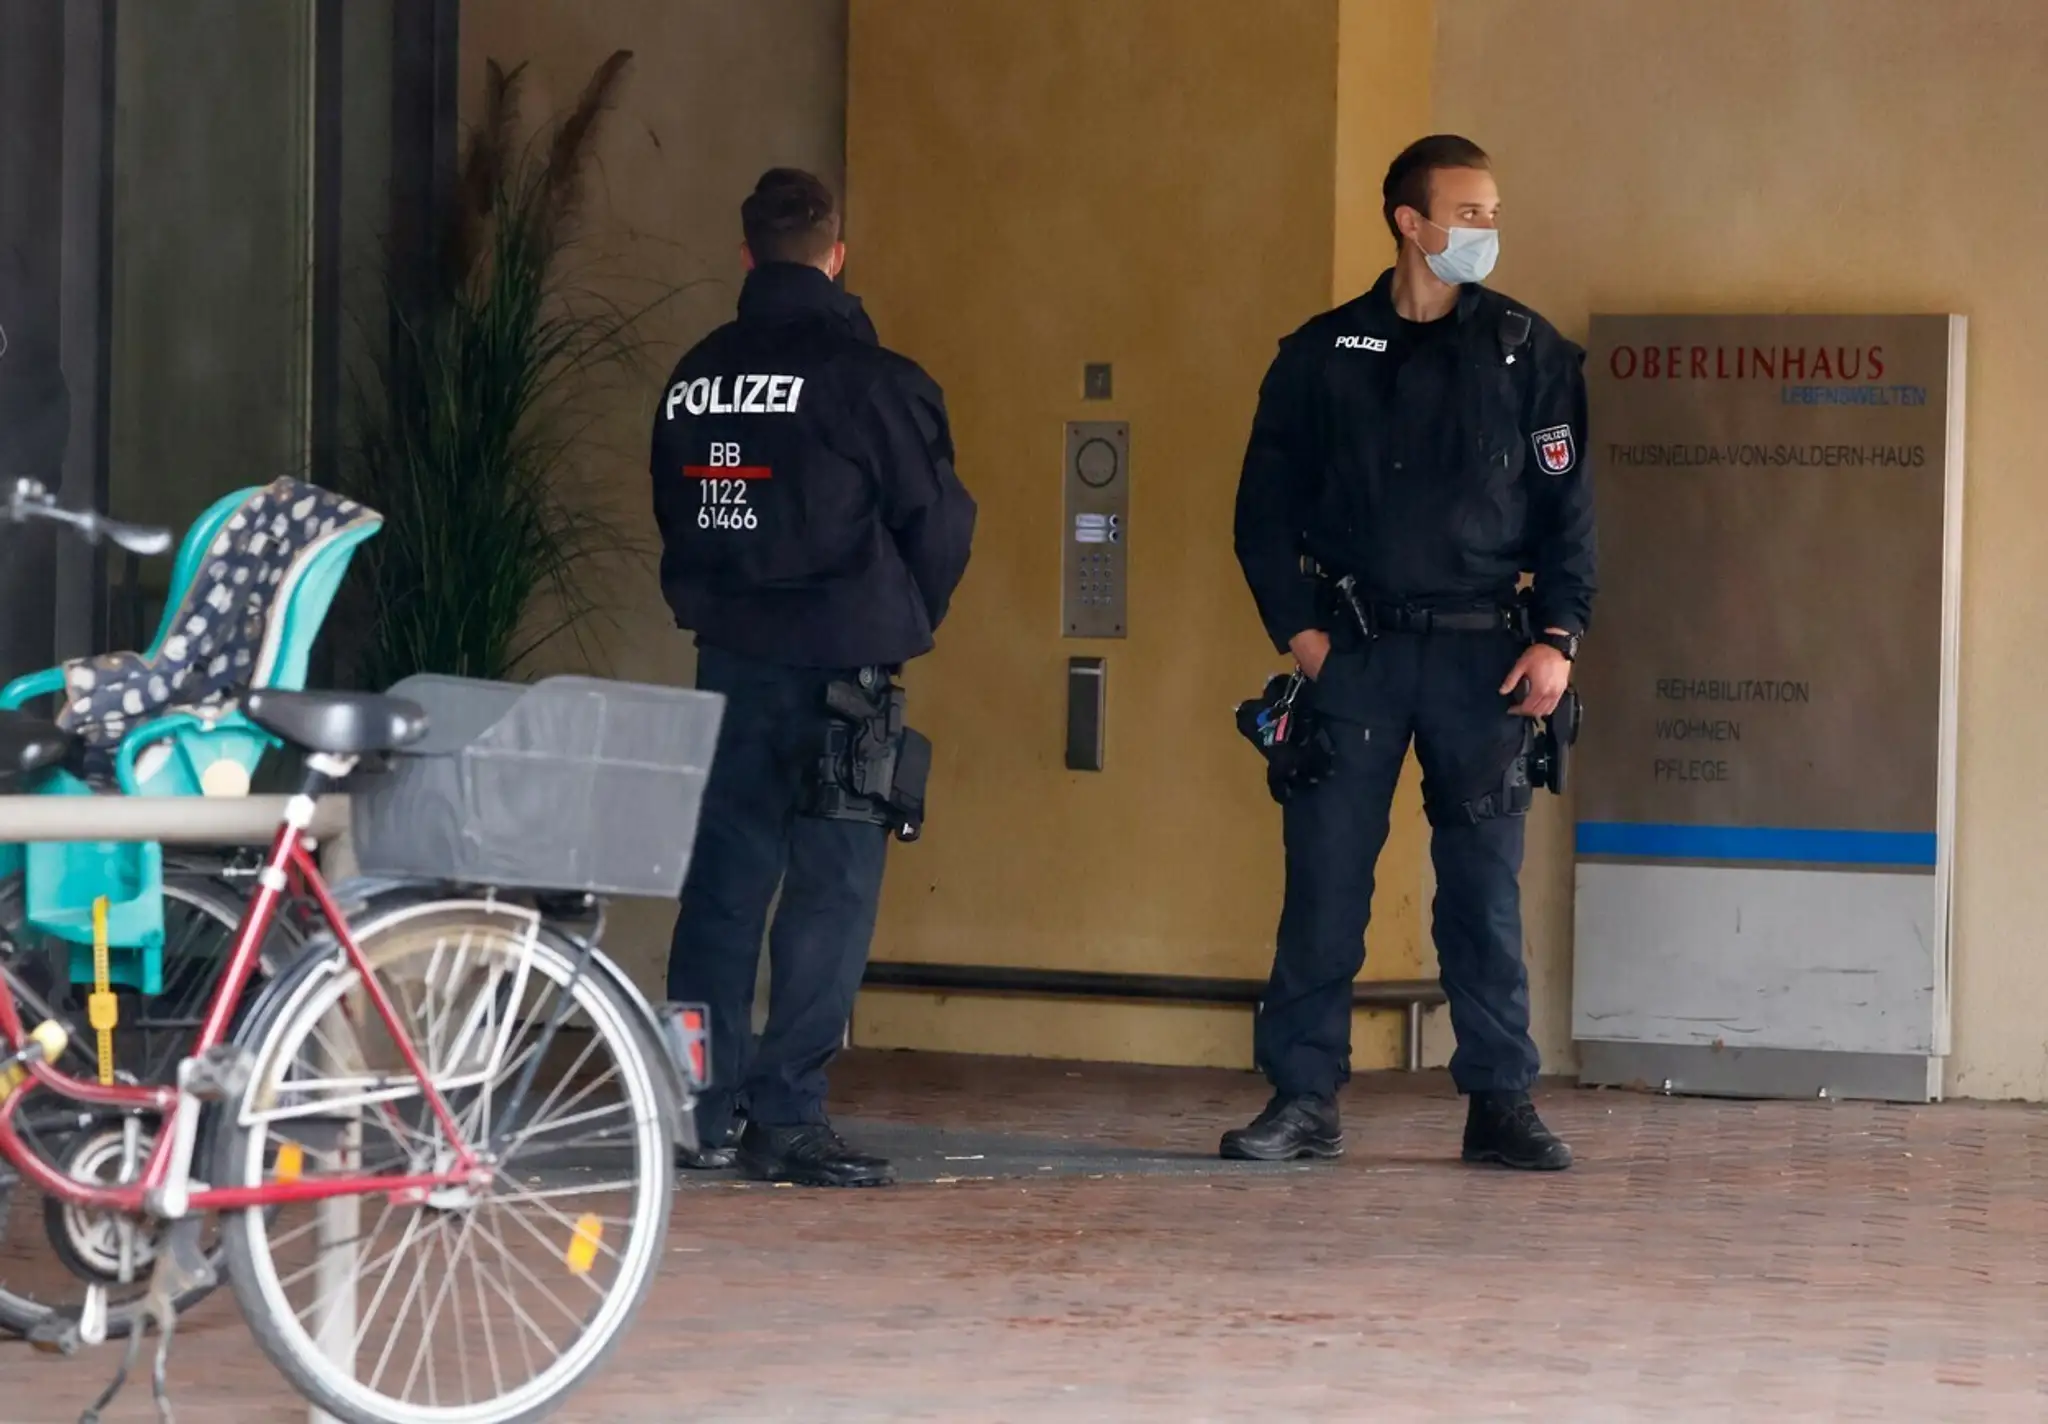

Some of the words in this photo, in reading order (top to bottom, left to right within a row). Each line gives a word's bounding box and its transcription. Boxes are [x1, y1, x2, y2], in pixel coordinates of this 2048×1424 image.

[1335, 336, 1387, 352] POLIZEI
[1610, 345, 1885, 380] OBERLINHAUS
[666, 374, 805, 420] POLIZEI
[1781, 385, 1926, 406] LEBENSWELTEN
[1535, 429, 1568, 444] POLIZEI
[709, 442, 741, 467] BB
[1609, 443, 1925, 468] THUSNELDA-VON-SALDERN-HAUS
[700, 478, 747, 504] 1122
[697, 506, 758, 529] 61466
[1656, 678, 1809, 702] REHABILITATION
[1656, 718, 1740, 741] WOHNEN
[1655, 758, 1729, 783] PFLEGE
